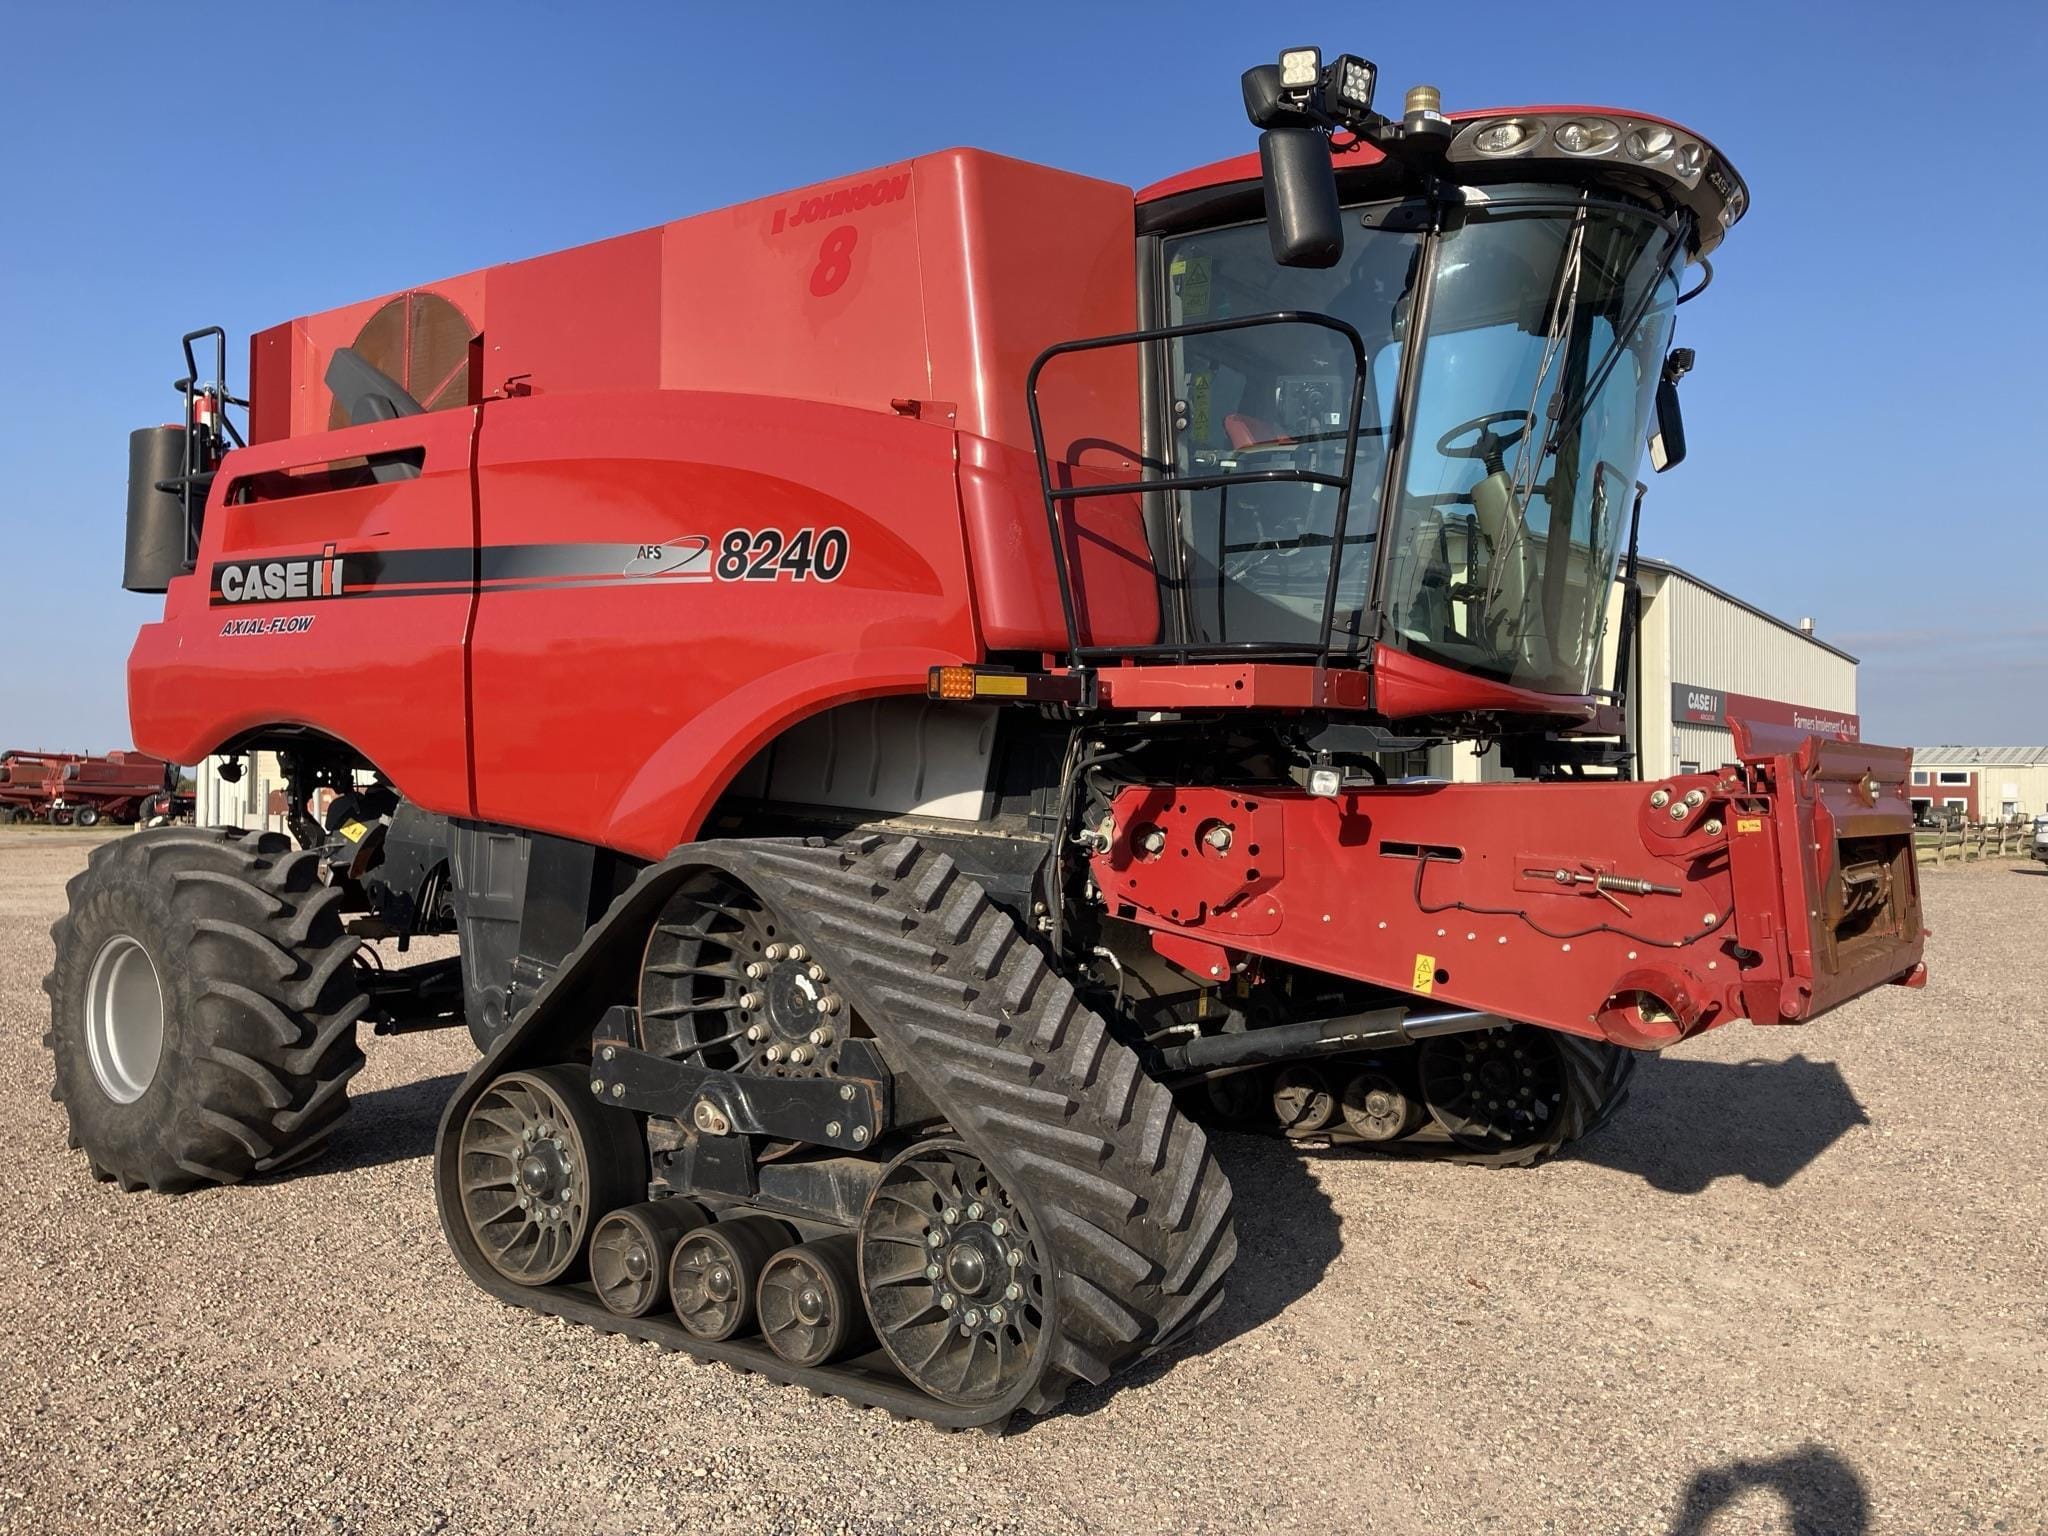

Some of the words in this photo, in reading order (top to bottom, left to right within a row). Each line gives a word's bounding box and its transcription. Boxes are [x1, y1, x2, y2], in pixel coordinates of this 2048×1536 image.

[789, 173, 911, 227] JOHNSON
[809, 225, 858, 297] 8
[637, 545, 662, 560] AFS
[716, 526, 848, 583] 8240
[221, 563, 308, 602] CASE
[219, 615, 315, 637] AXIAL-FLOW
[1688, 692, 1710, 711] CASE
[1794, 711, 1815, 731] Farmers
